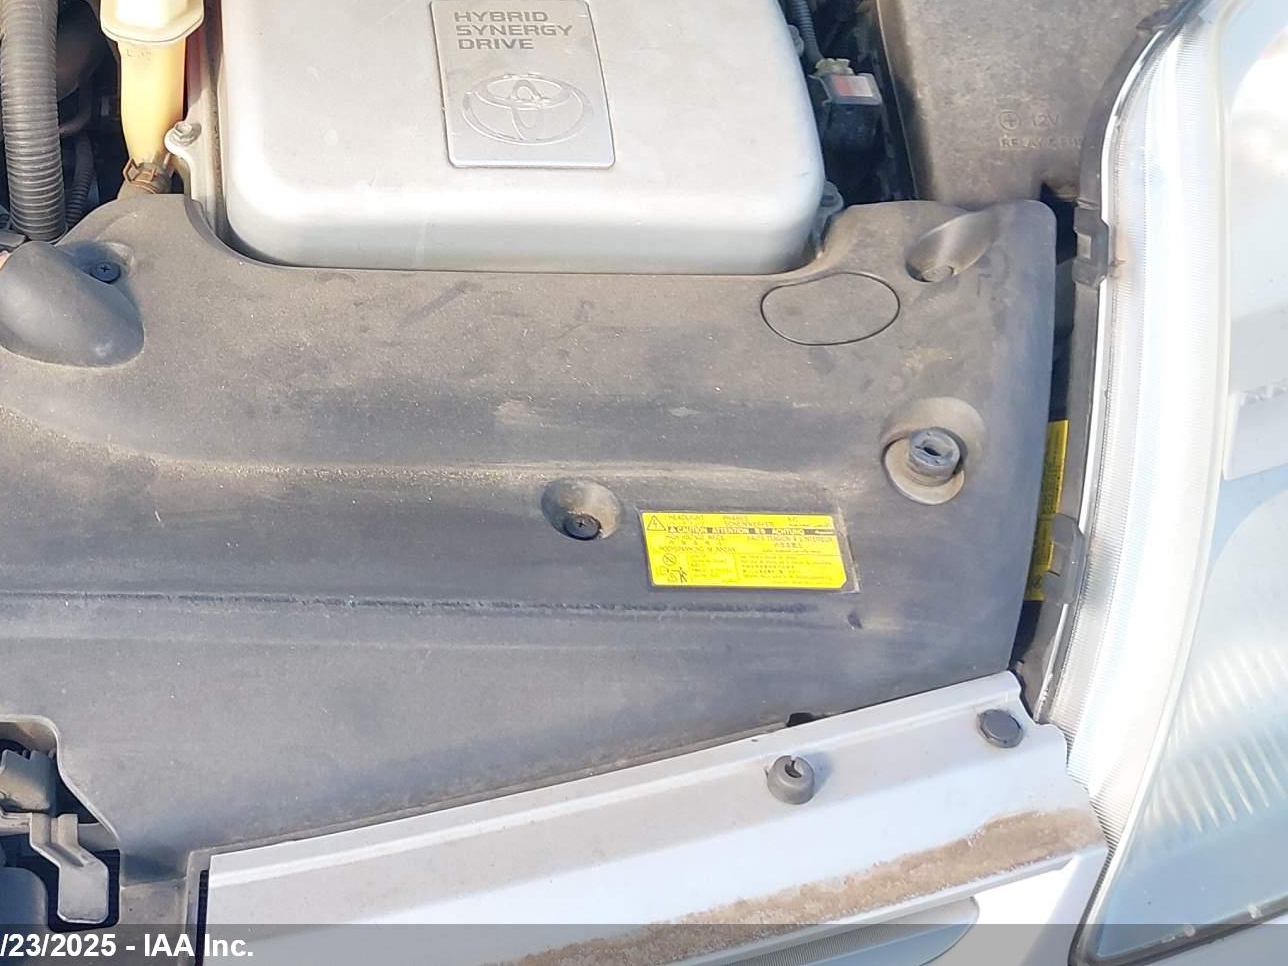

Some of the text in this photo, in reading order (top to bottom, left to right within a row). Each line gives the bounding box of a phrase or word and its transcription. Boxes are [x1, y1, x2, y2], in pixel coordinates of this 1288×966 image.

[454, 11, 549, 23] HYBRID
[456, 25, 573, 37] SYNERGY
[458, 38, 534, 51] DRIVE
